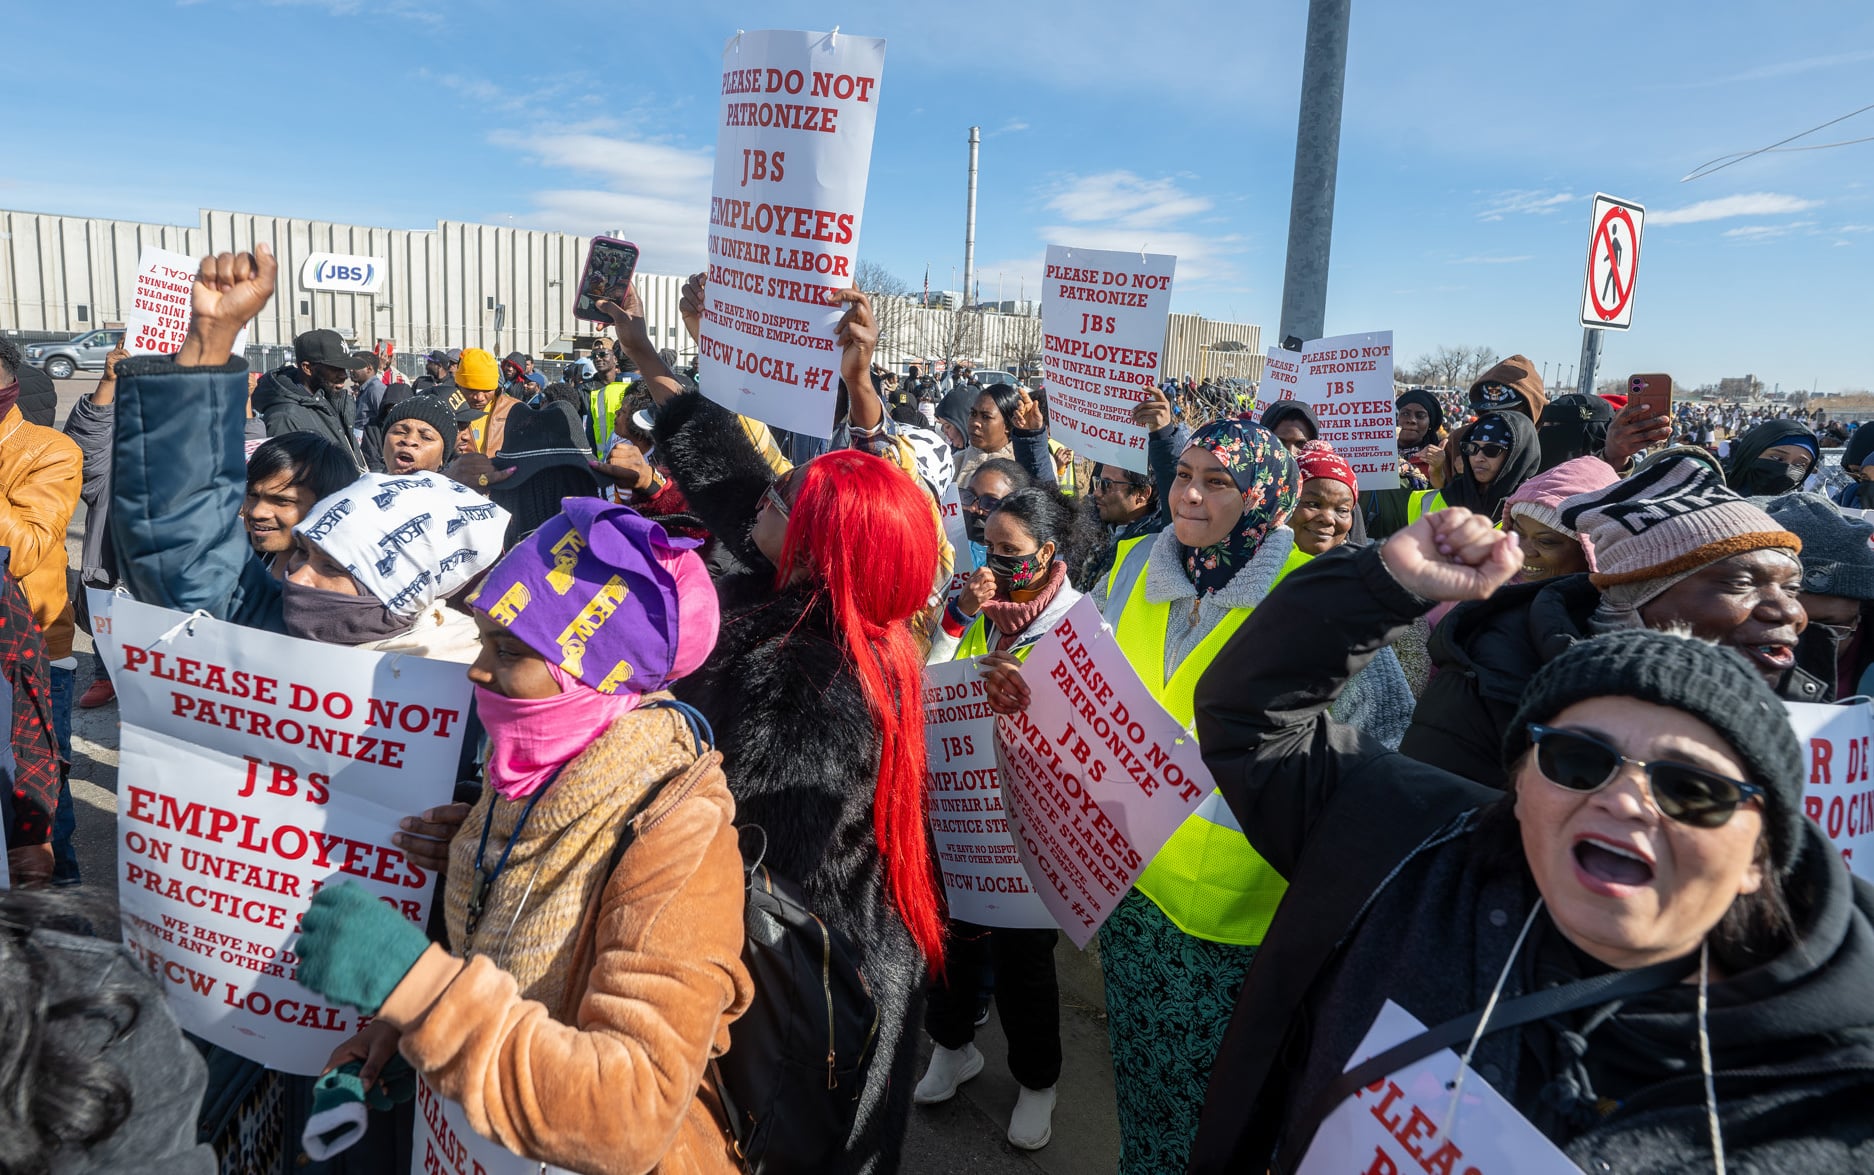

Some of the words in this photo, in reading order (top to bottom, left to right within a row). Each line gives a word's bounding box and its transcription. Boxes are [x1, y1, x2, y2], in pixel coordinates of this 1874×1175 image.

[722, 68, 762, 95] PLEASE
[766, 68, 804, 94] DO
[810, 72, 874, 102] NOT
[726, 103, 838, 134] PATRONIZE
[741, 148, 785, 187] JBS
[710, 196, 854, 244] EMPLOYEES
[150, 264, 156, 273] 7
[708, 234, 720, 254] ON
[722, 238, 770, 266] UNFAIR
[774, 247, 849, 277] LABOR
[162, 266, 197, 282] OCAL
[326, 266, 362, 281] JBS
[710, 264, 764, 295] RACTICE
[1046, 264, 1099, 284] PLEASE
[1102, 272, 1128, 286] DO
[1132, 274, 1170, 290] NOT
[135, 298, 185, 318] INJUSTAS
[138, 287, 186, 306] DISPUTAS
[1060, 284, 1148, 308] PATRONIZE
[142, 325, 165, 338] POR
[704, 310, 718, 324] WITH
[719, 315, 732, 328] ANY
[735, 320, 764, 338] OTHER
[766, 329, 834, 352] EMPLOYER
[714, 300, 724, 312] WE
[724, 304, 744, 318] HAVE
[746, 310, 760, 322] NO
[762, 312, 810, 332] DISPUTE
[1080, 313, 1116, 334] JBS
[701, 335, 734, 366] UFCW
[736, 349, 798, 386] LOCAL
[804, 366, 834, 392] #7
[1044, 334, 1158, 369] EMPLOYEES
[1266, 358, 1294, 372] PLEASE
[1302, 350, 1337, 364] PLEASE
[1340, 348, 1358, 360] DO
[1362, 346, 1390, 358] NOT
[1044, 355, 1060, 368] ON
[1062, 360, 1106, 379] UNFAIR
[1109, 369, 1155, 387] LABOR
[1046, 370, 1101, 394] PRACTICE
[1270, 370, 1297, 384] PATRO
[1310, 360, 1376, 375] PATRONIZE
[1058, 392, 1068, 401] WE
[1068, 396, 1086, 406] HAVE
[1088, 402, 1098, 410] NO
[1278, 388, 1296, 400] JB
[1326, 381, 1354, 398] JBS
[1049, 395, 1063, 406] WITH
[1064, 402, 1076, 411] ANY
[1078, 407, 1102, 418] OTHER
[1312, 400, 1392, 415] MPLOYEES
[1050, 408, 1078, 430] UFCW
[1081, 422, 1126, 446] LOCAL
[1128, 435, 1146, 450] #7
[1318, 419, 1352, 428] NFAIR
[1354, 418, 1394, 427] LABOR
[1352, 430, 1394, 440] STRIKE
[1352, 464, 1378, 474] CAL
[1381, 463, 1396, 472] #7
[1623, 484, 1747, 532] NIK
[122, 644, 278, 705] PLEASE
[288, 683, 353, 720] DO
[365, 698, 459, 738] NOT
[945, 684, 968, 700] DO
[1054, 618, 1114, 706] PLEASE
[1110, 701, 1146, 744] DO
[1144, 742, 1202, 804] NOT
[170, 692, 406, 769] PATRONIZE
[1050, 660, 1160, 798] PATRONIZE
[942, 736, 974, 762] JBS
[1057, 722, 1107, 783] JBS
[1846, 736, 1868, 784] DE
[238, 755, 331, 805] JBS
[940, 798, 982, 812] UNFAIR
[998, 714, 1018, 745] ON
[1018, 744, 1071, 817] UNFAIR
[1072, 814, 1130, 886] LABOR
[126, 786, 428, 889] EMPLOYEES
[932, 818, 984, 833] PRACTICE
[986, 819, 1010, 832] STR
[126, 831, 172, 864] ON
[180, 847, 301, 898] UNFAIR
[946, 844, 956, 852] WE
[956, 844, 974, 854] HAVE
[976, 845, 986, 854] NO
[988, 845, 1016, 854] DISPUT
[954, 854, 966, 862] ANY
[968, 856, 993, 864] OTHER
[1022, 807, 1050, 848] OTHER
[1050, 848, 1102, 912] EMPLOYER
[1036, 816, 1048, 834] NO
[1050, 836, 1087, 886] DISPUTE
[1059, 824, 1120, 897] STRIKE
[944, 872, 973, 890] UFCW
[976, 877, 1028, 893] LOCAL
[1018, 823, 1068, 902] LOCAL
[1072, 900, 1096, 928] #7
[126, 862, 288, 930] PRACTICE
[161, 914, 189, 935] WE
[193, 926, 242, 950] HAVE
[246, 942, 276, 959] NO
[177, 936, 216, 958] ANY
[220, 951, 286, 978] OTHER
[224, 983, 346, 1032] LOCAL
[418, 1075, 468, 1175] PLEASE
